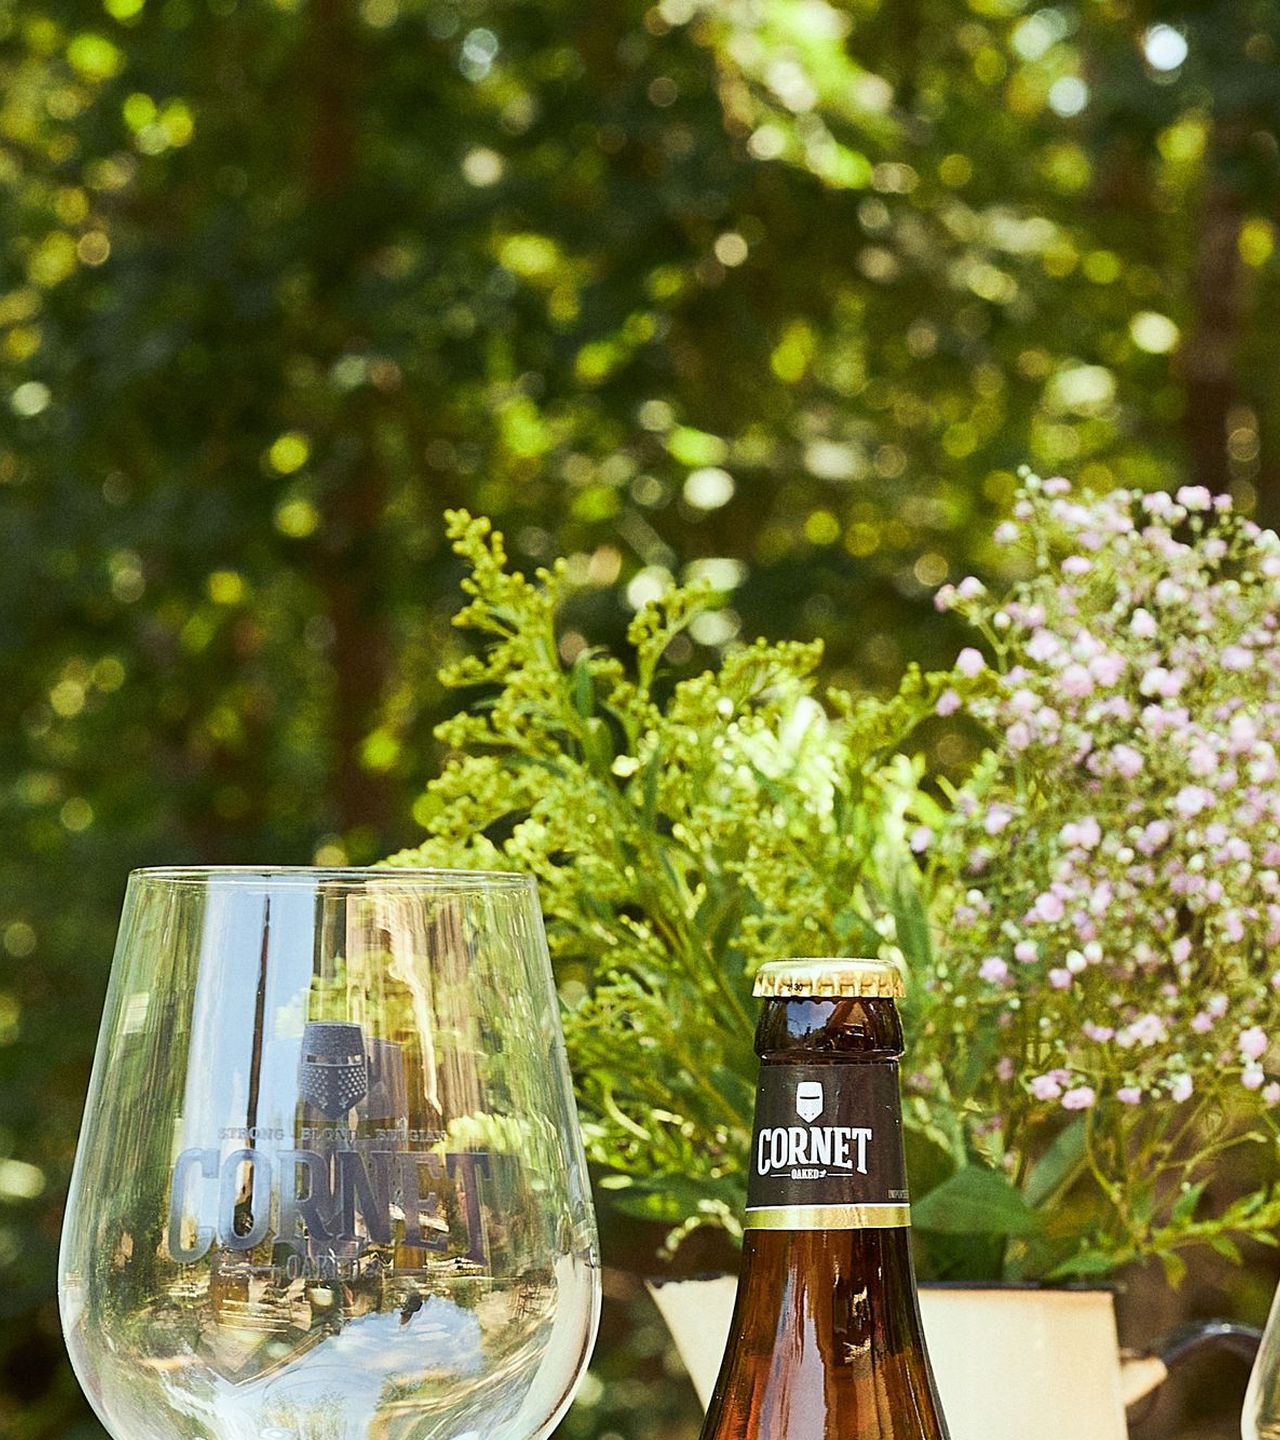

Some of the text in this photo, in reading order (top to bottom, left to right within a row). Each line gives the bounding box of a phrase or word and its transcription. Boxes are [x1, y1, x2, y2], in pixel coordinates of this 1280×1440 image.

[757, 1126, 872, 1176] CORNET
[791, 1168, 818, 1180] OAKED
[170, 1147, 492, 1267] CORNET
